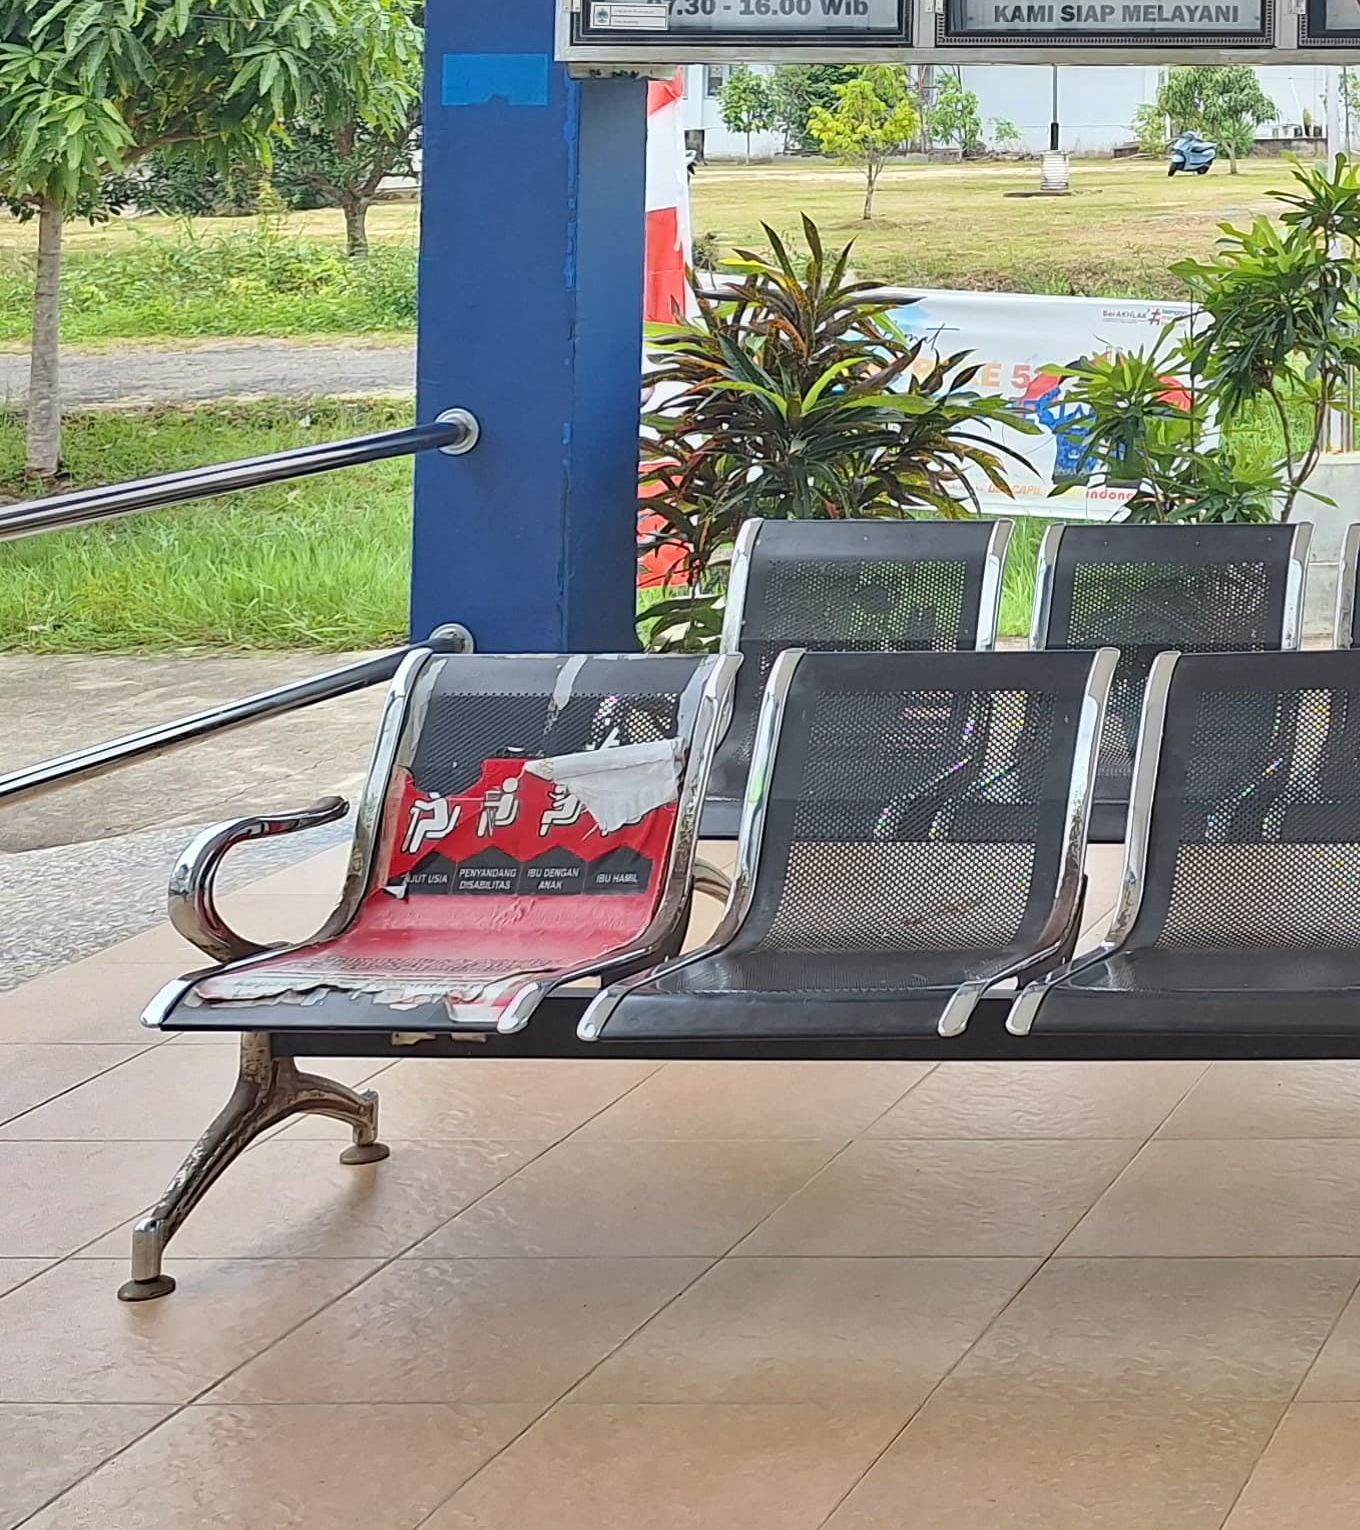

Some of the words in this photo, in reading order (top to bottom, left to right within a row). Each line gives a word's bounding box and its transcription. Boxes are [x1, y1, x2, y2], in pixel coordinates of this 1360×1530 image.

[994, 5, 1053, 23] KAMI
[1060, 5, 1115, 23] SIAP
[1121, 5, 1239, 23] MELAYANI
[459, 868, 517, 878] PENYANDANG
[527, 868, 541, 878] IBU
[543, 868, 579, 878] DENGAN
[596, 873, 611, 883] IBU
[612, 873, 638, 883] HAMIL
[427, 873, 448, 884] USIA
[459, 880, 512, 890] DISABILITAS
[538, 880, 563, 890] ANAK
